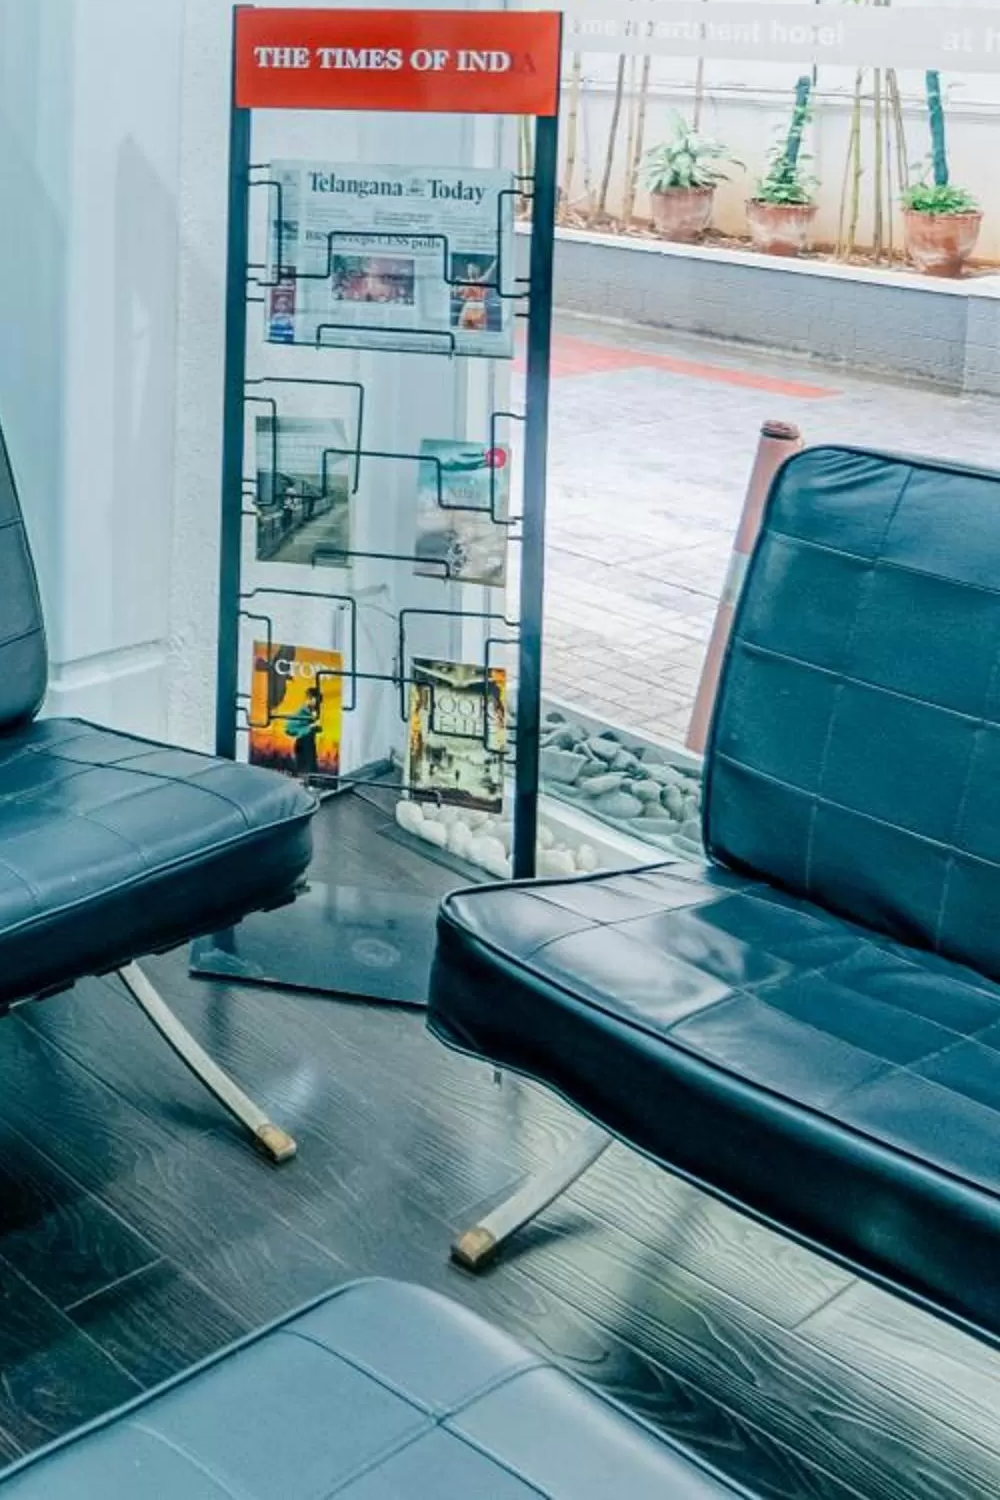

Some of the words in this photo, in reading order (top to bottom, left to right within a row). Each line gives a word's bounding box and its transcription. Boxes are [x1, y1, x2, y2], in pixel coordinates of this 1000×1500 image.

[253, 46, 310, 69] THE
[316, 47, 403, 71] TIMES
[409, 49, 450, 72] OF
[308, 171, 404, 198] Telangana
[427, 179, 487, 205] Today
